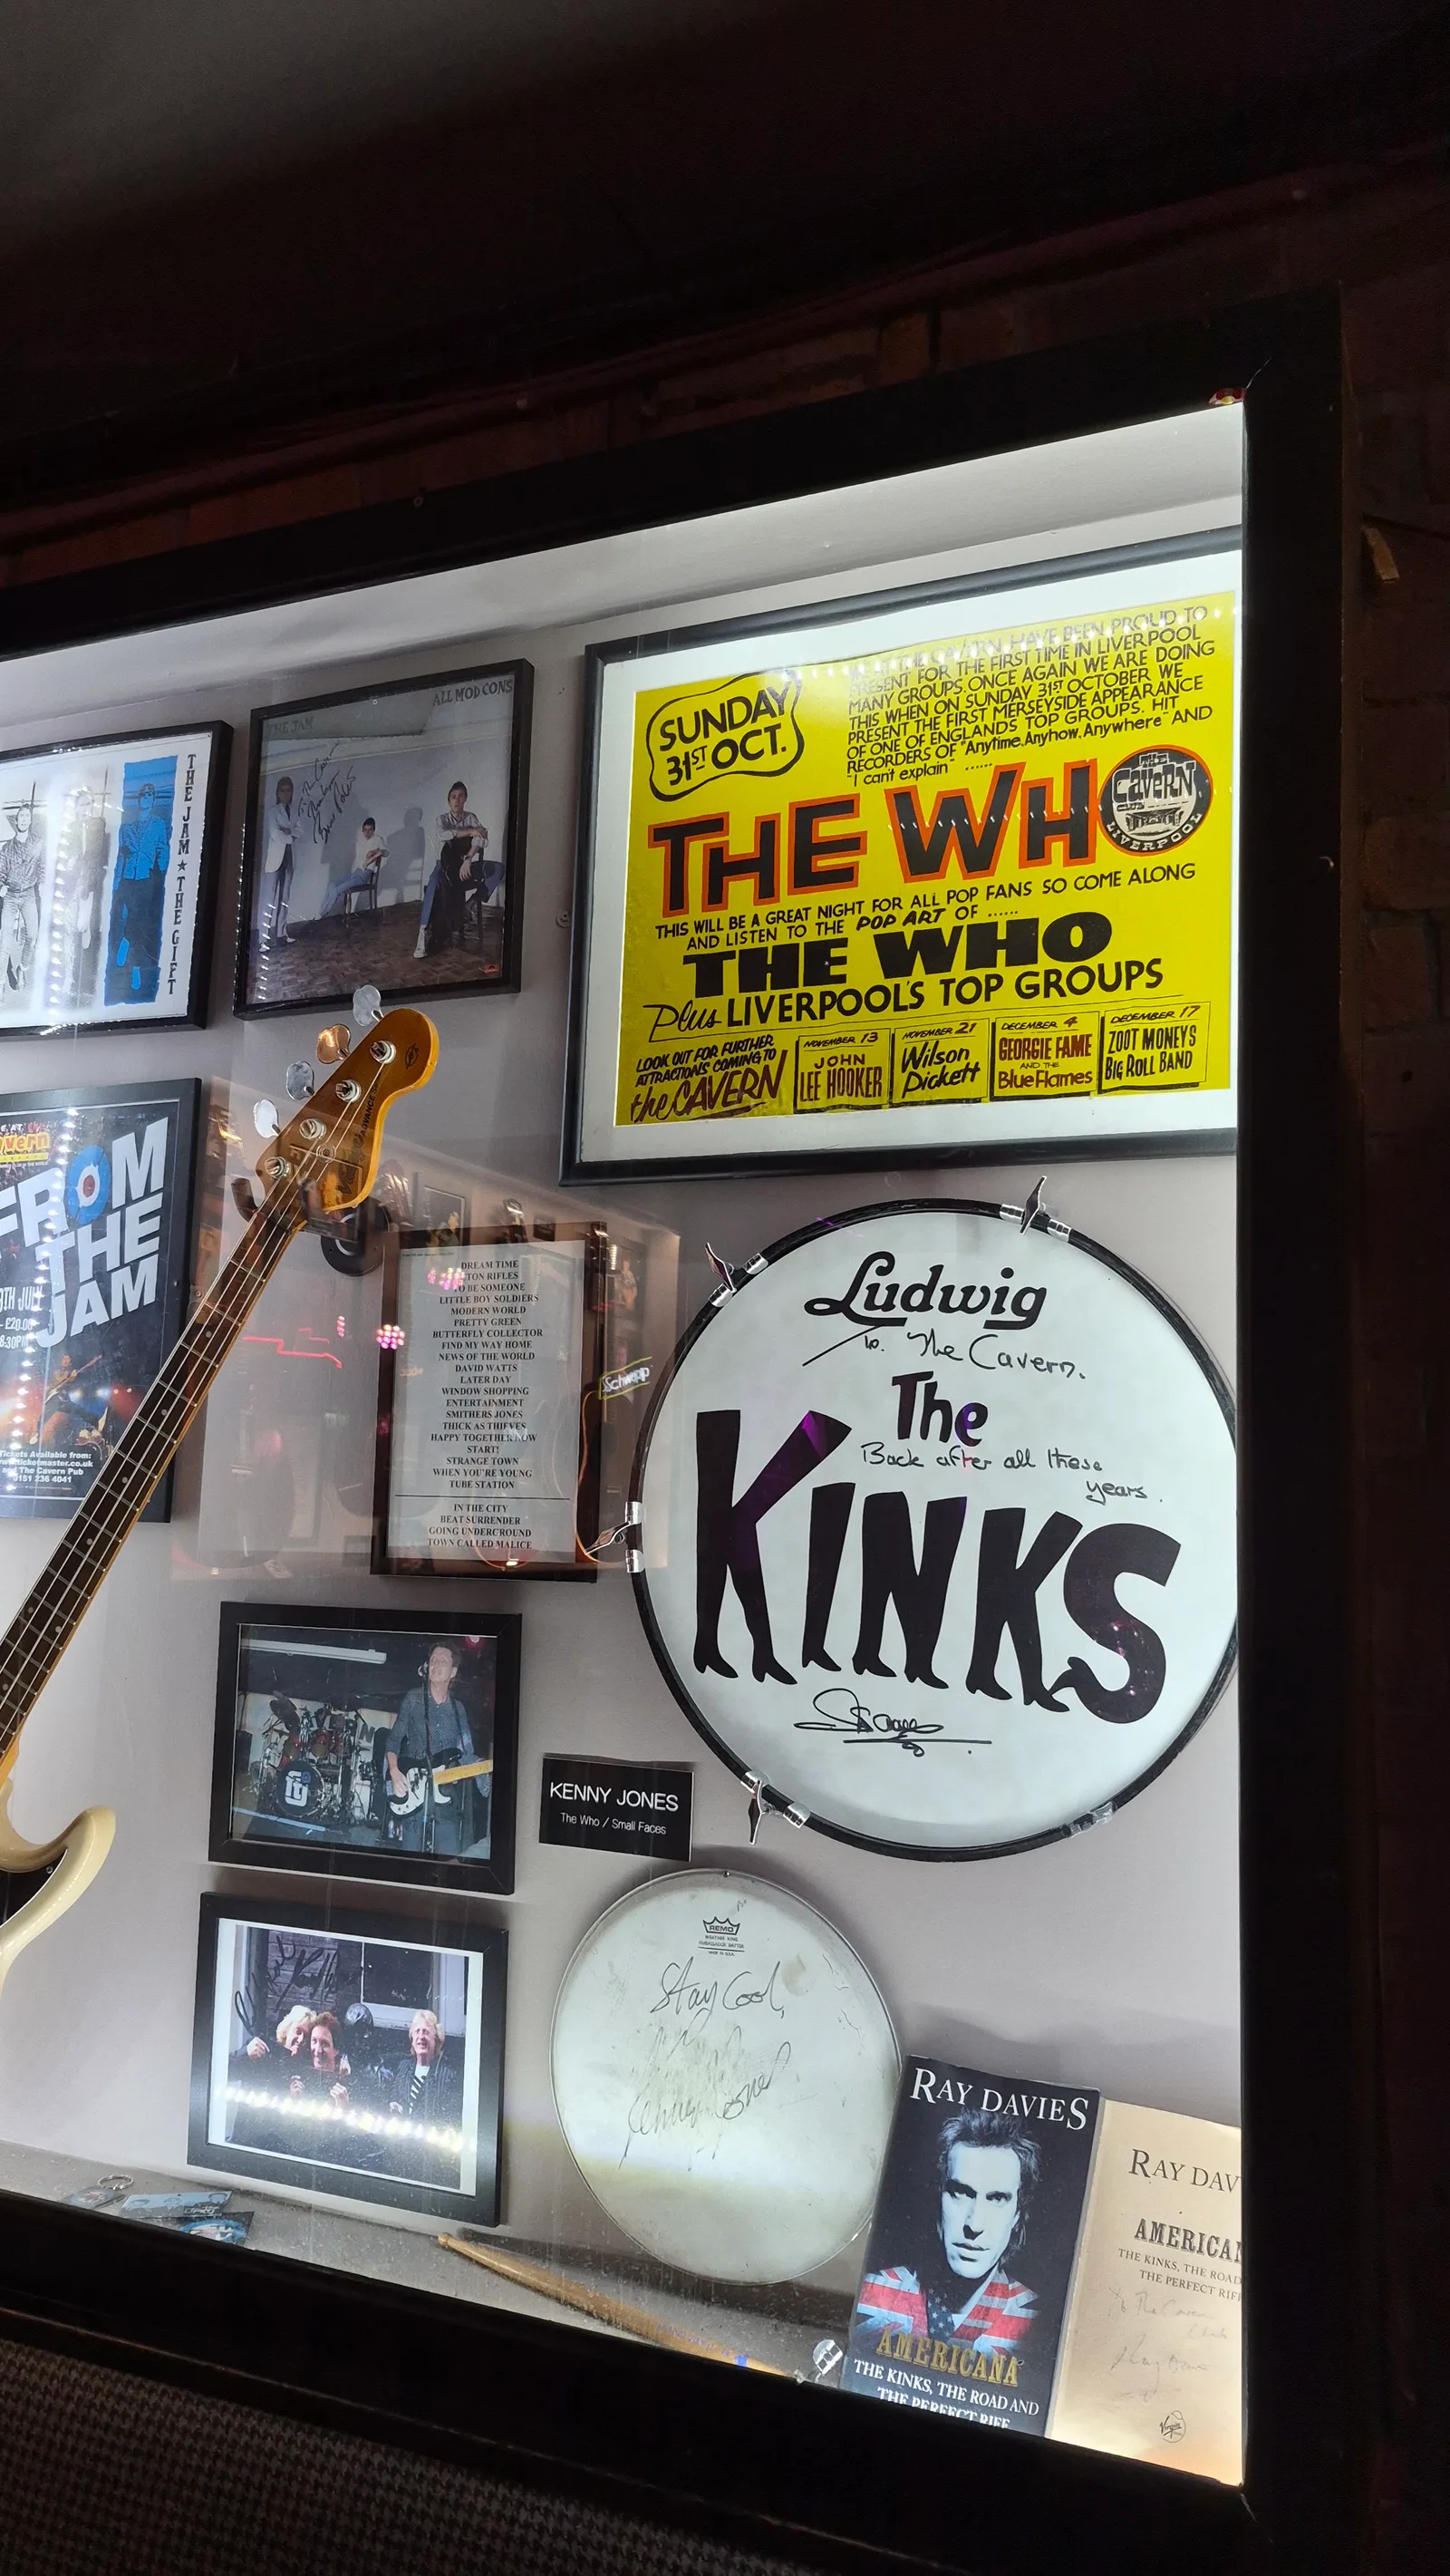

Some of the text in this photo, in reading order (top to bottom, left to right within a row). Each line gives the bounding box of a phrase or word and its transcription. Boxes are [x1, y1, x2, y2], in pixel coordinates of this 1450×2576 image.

[432, 681, 512, 706] ALL MOD CONS
[660, 681, 790, 751] SUNDAY
[848, 674, 1204, 745] PRESENT THE FIRST MERSEYSIDE APPEARANCE
[291, 716, 314, 733] JAM
[667, 723, 787, 786] 31ST OCT.
[1107, 813, 1203, 851] LIVERPOOL
[648, 793, 867, 918] THE
[168, 753, 196, 995] THE JAM THE GIFT
[655, 863, 1195, 939] THIS WILL BE A GREAT NIGHT FOR ALL POP FANS SO COME ALONG
[683, 911, 1112, 999] THE WHO
[643, 999, 721, 1042] Plus
[940, 973, 1003, 1006] TOP
[1015, 958, 1163, 999] GROUPS
[1110, 1005, 1201, 1024] DECEMBER 17
[902, 1022, 976, 1040] NOVEMBER 21
[1001, 1016, 1078, 1031] DECEMBER 4
[803, 1031, 878, 1048] NOVEMBER 13
[998, 1033, 1093, 1062] GEORGIE FAME
[1107, 1024, 1196, 1053] ZOOT MONEYS
[814, 1053, 865, 1070] JOHN
[901, 1040, 970, 1073] Wilson
[1043, 1060, 1059, 1069] THE
[1125, 1051, 1156, 1077] ROLL
[1159, 1050, 1193, 1071] BAND
[631, 1050, 788, 1124] the CAVERN
[800, 1066, 883, 1102] LEE HOOKER
[35, 1192, 164, 1295] THE
[35, 1254, 160, 1349] JAM
[804, 1251, 1047, 1330] Ludwig
[450, 1305, 527, 1315] MODERN WORLD
[454, 1317, 522, 1327] PRETTY GREEN
[432, 1328, 543, 1339] BUTTERFLY COLLECTOR
[455, 1363, 517, 1373] DAVID WATTS
[907, 1328, 1086, 1379] The Cavern.
[441, 1387, 529, 1396] WINDOW SHOPPING
[446, 1399, 524, 1408] ENTERTAINMENT
[446, 1410, 523, 1419] SMITHERS JONES
[892, 1370, 989, 1447] The
[446, 1457, 519, 1466] STRANGE TOWN
[861, 1441, 924, 1467] Back
[936, 1446, 991, 1470] after
[1003, 1448, 1036, 1468] all
[34, 1475, 51, 1483] 236
[449, 1480, 515, 1489] TUBE STATION
[429, 1526, 532, 1537] GOING UNDERGROUND
[440, 1515, 520, 1525] BEAT SURRENDER
[693, 1410, 1182, 1724] KINKS
[550, 1782, 679, 1812] KENNY JONES
[561, 1813, 666, 1835] The Who Small Faces
[650, 1956, 719, 2019] Stay
[910, 2068, 1089, 2131] RAY DAVIES
[1128, 2148, 1185, 2182] RAY
[1118, 2248, 1242, 2285] THE KINKS, THE ROAD
[1140, 2270, 1163, 2283] THE
[1165, 2276, 1216, 2295] PERFECT
[876, 2326, 1019, 2387] AMERICANA
[855, 2358, 1039, 2416] THE KINKS, THE ROAD AND
[1159, 2416, 1182, 2438] Virgin
